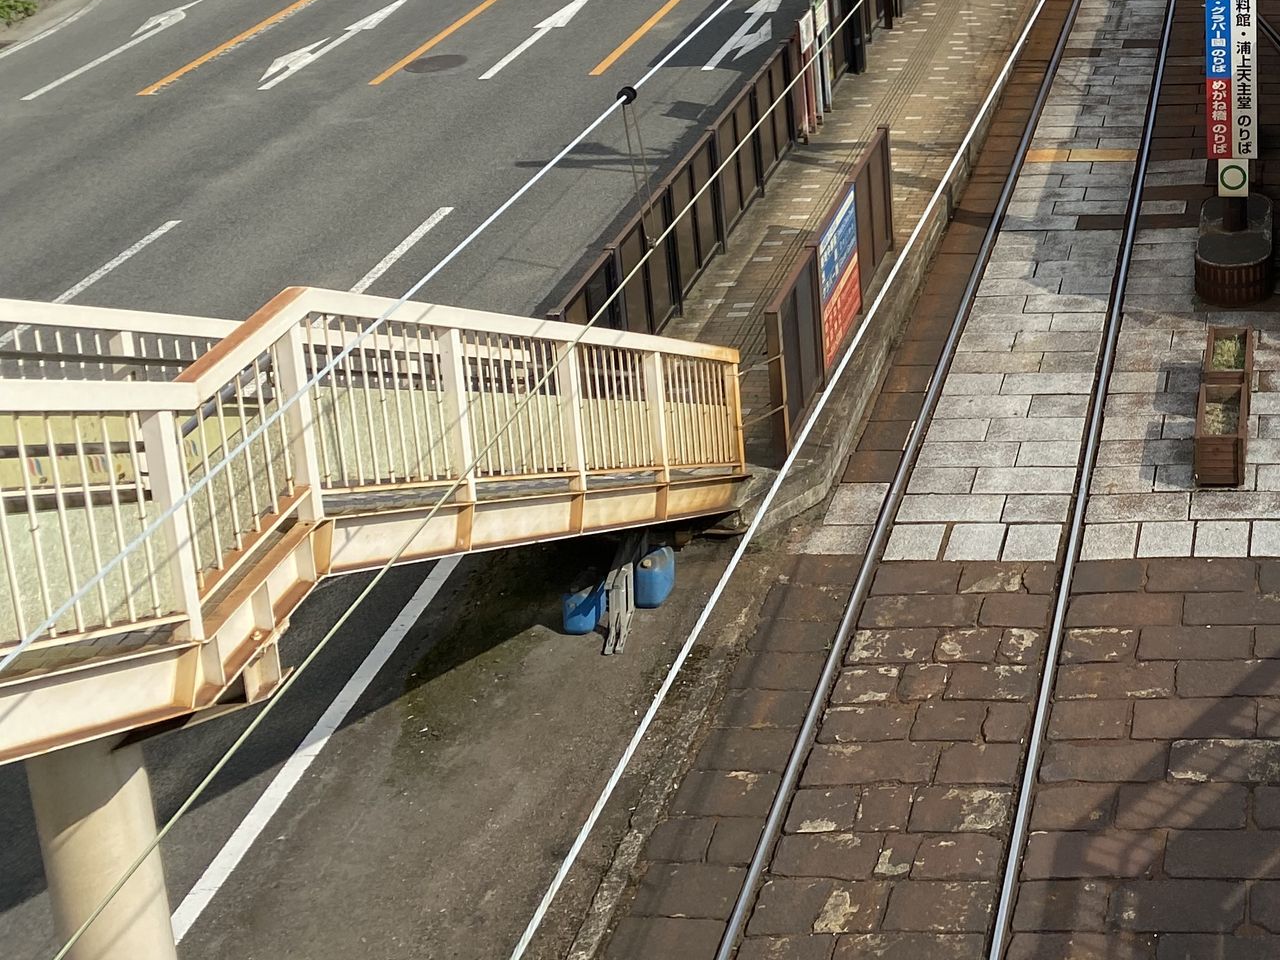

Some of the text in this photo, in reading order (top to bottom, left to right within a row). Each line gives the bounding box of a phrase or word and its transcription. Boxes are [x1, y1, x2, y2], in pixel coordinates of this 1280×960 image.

[1211, 48, 1226, 74] のりば
[1211, 79, 1228, 155] めがね橋 のりば
[1236, 115, 1252, 155] のりば
